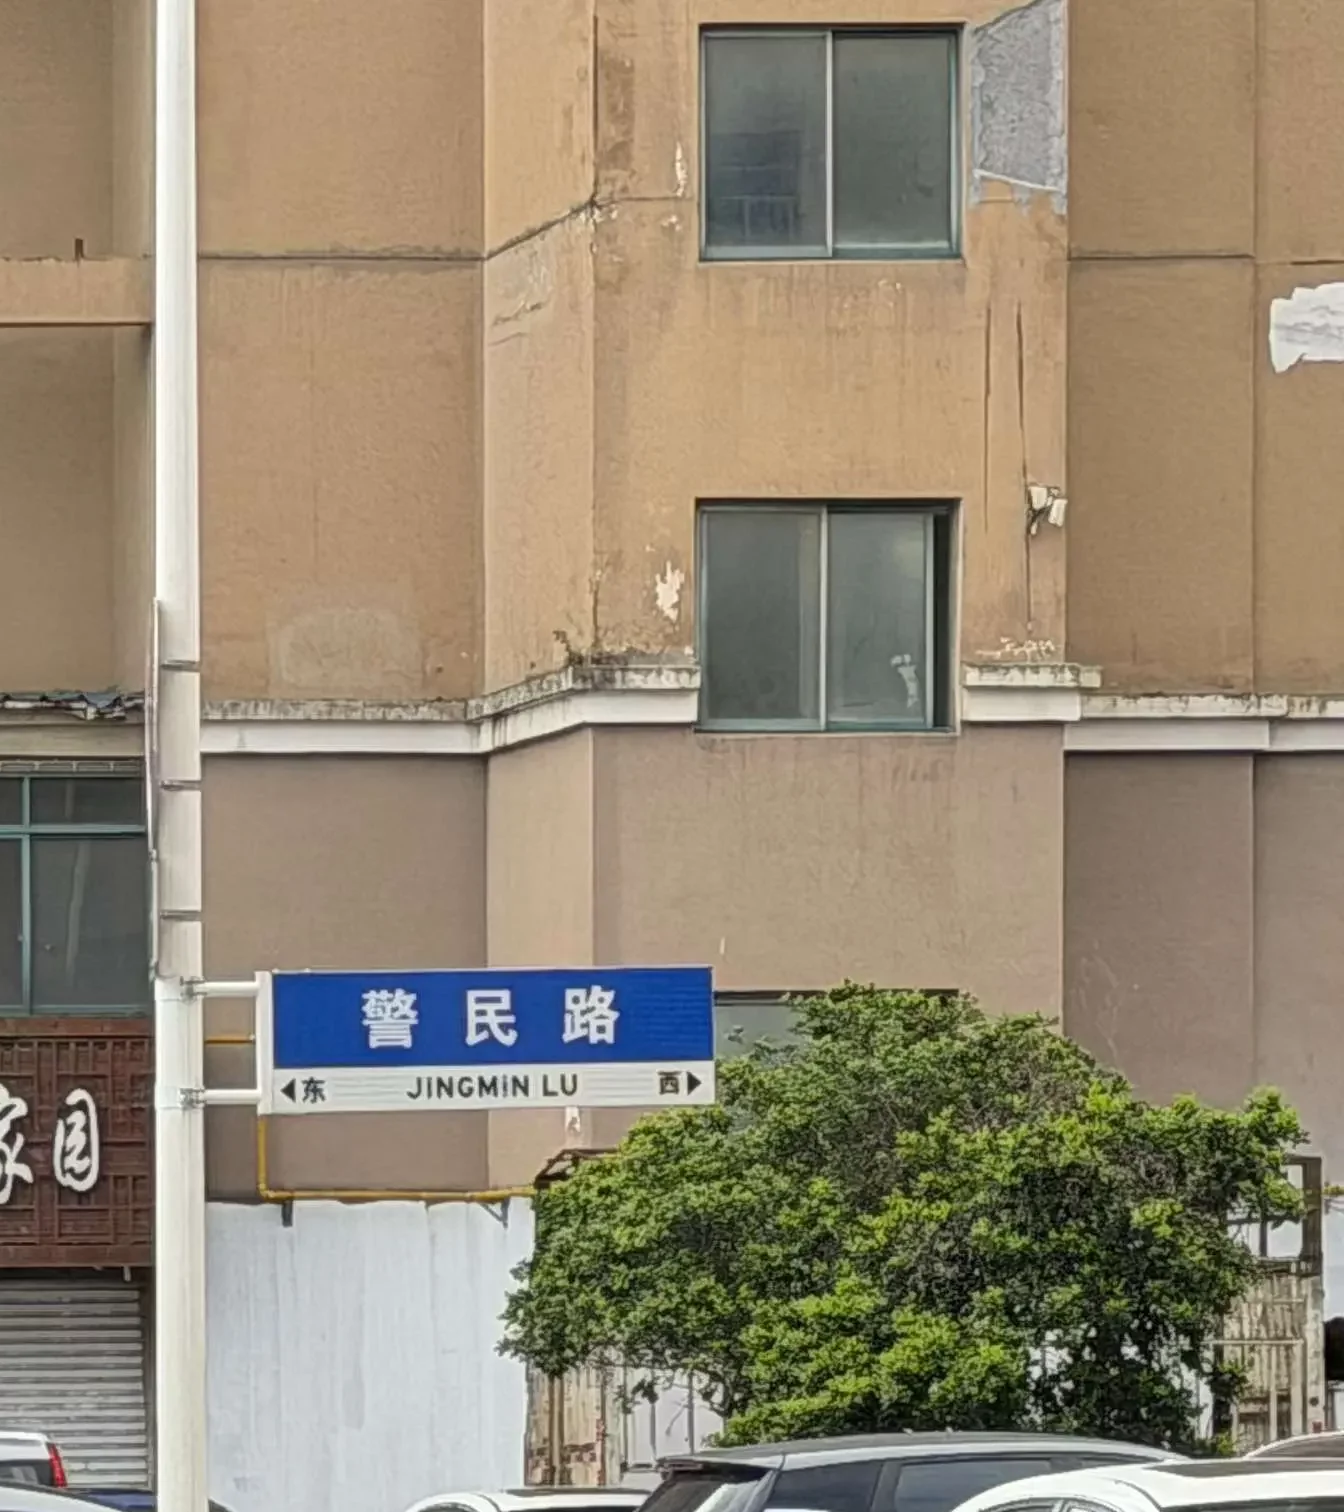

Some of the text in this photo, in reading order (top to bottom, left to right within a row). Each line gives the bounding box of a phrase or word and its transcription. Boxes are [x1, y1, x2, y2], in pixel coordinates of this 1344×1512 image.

[362, 985, 619, 1048] 警民路
[302, 1077, 326, 1103] 东
[407, 1073, 578, 1099] JINGMIN LU
[658, 1070, 681, 1095] 西
